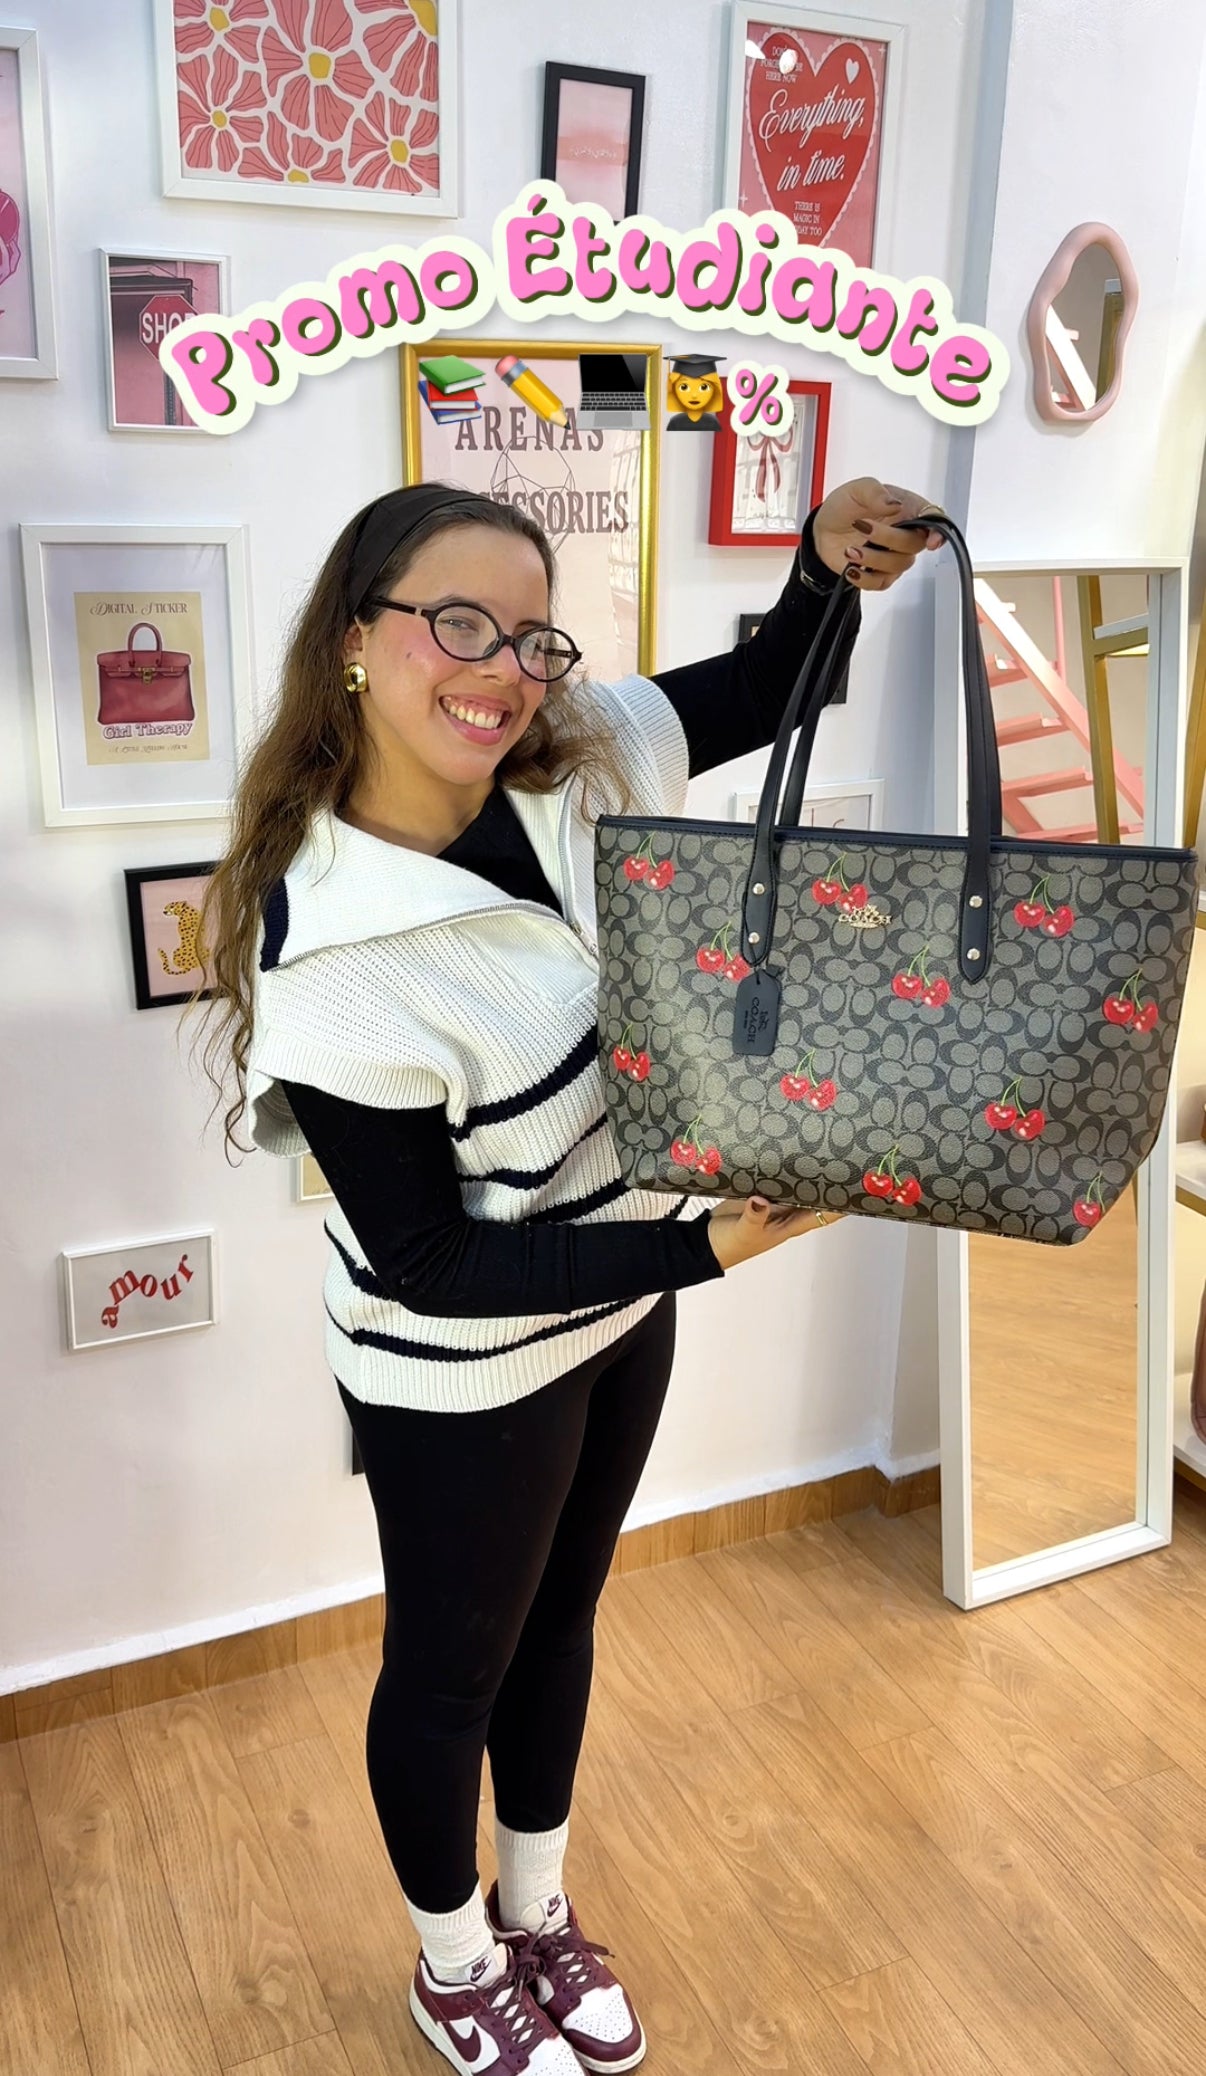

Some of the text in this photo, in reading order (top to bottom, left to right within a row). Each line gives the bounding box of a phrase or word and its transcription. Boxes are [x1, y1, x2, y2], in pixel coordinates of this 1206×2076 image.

[759, 84, 866, 152] Everything,
[776, 149, 845, 192] in time.
[141, 602, 188, 616] STICKER
[103, 722, 193, 740] Girl Therapy
[101, 1254, 194, 1329] amour
